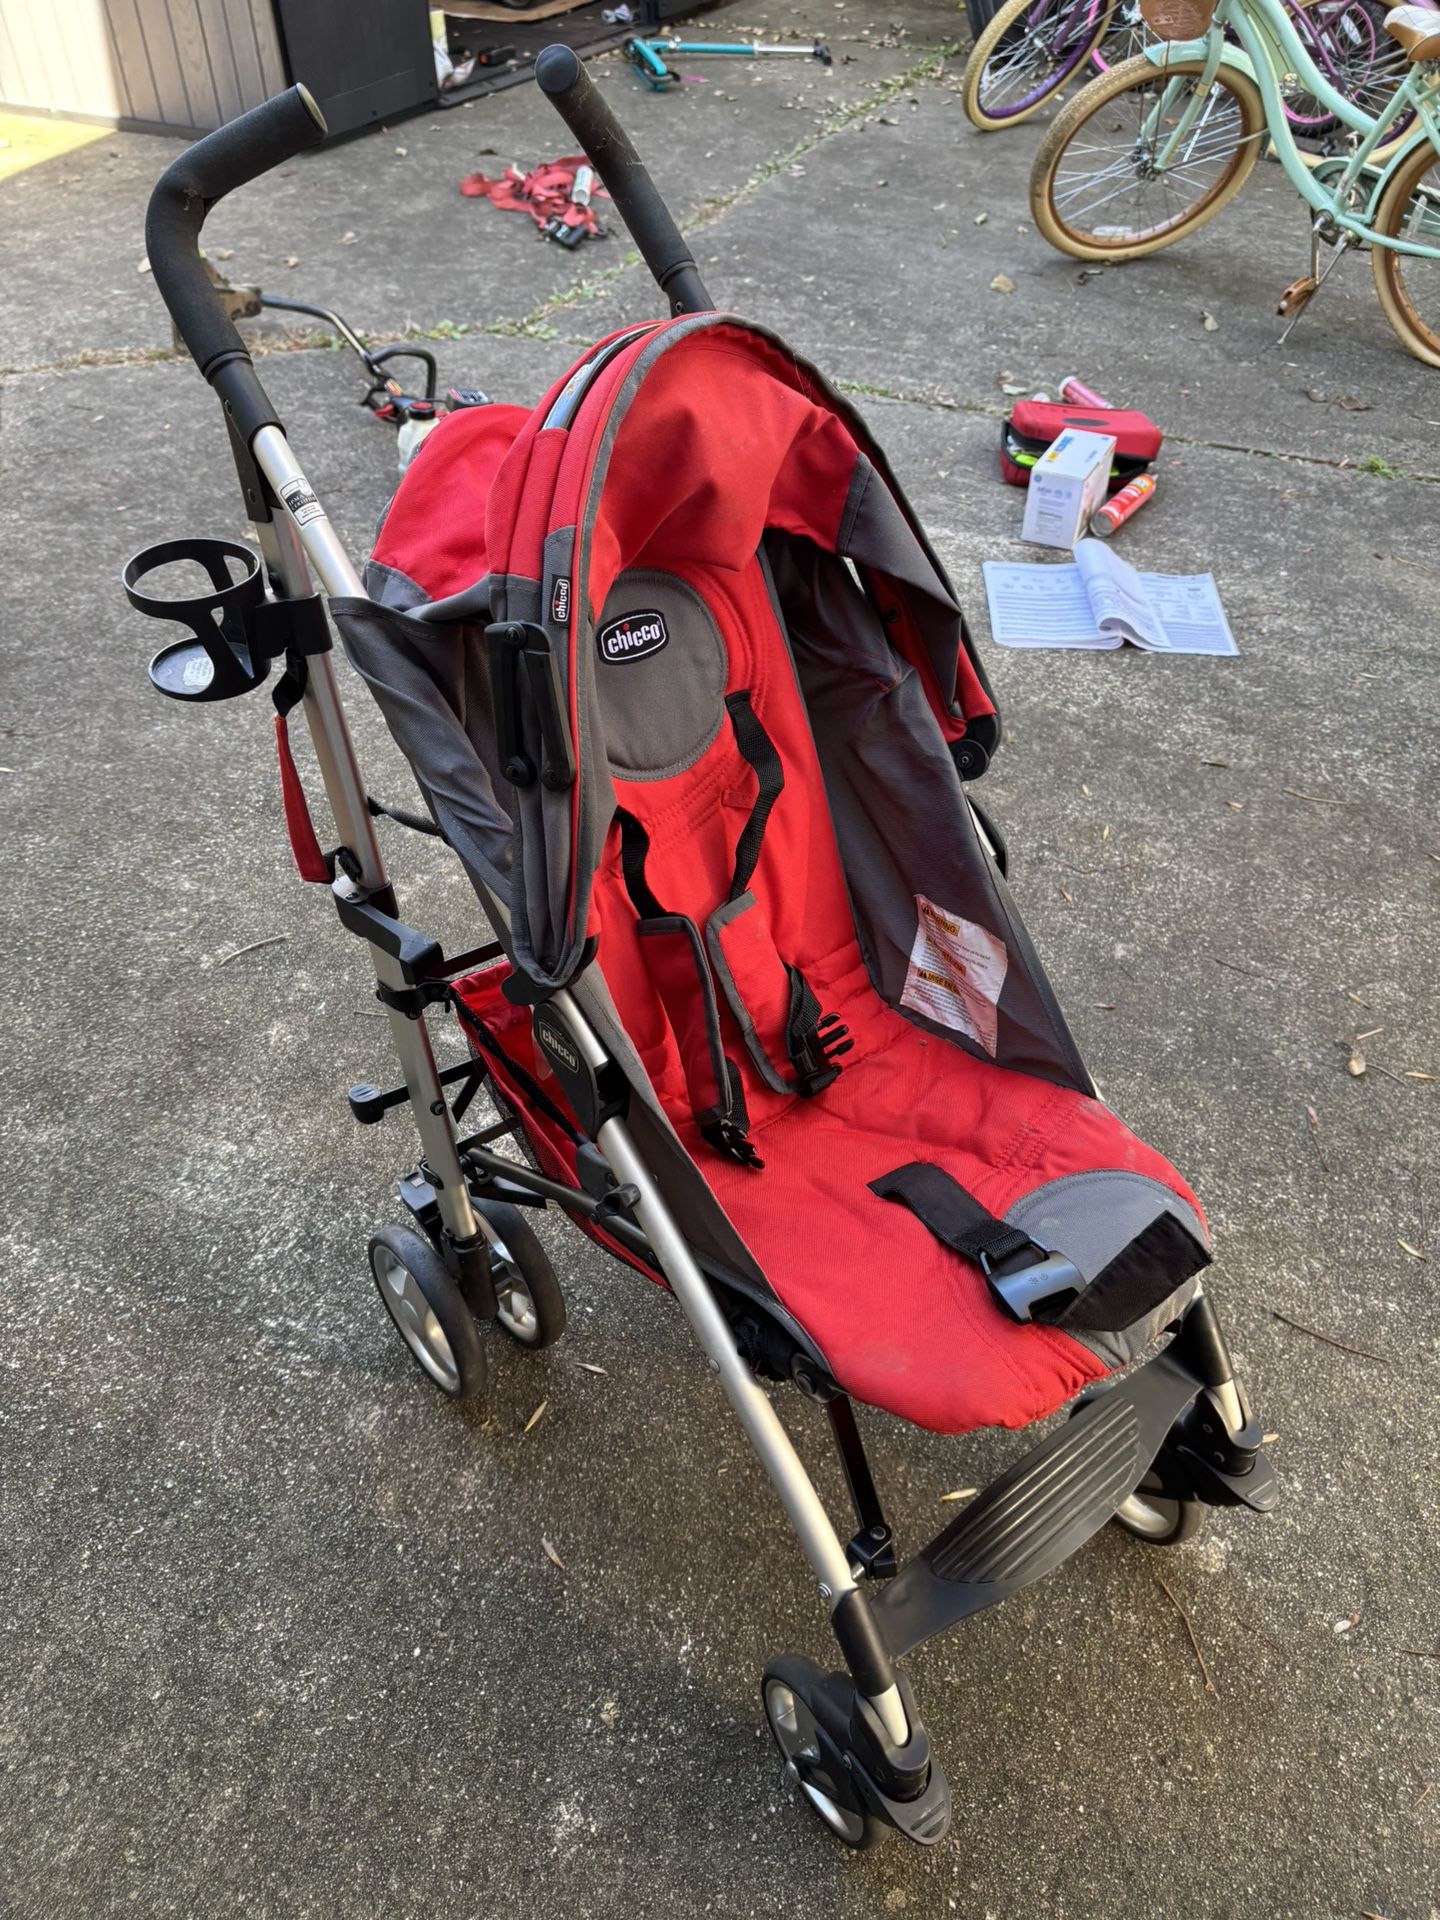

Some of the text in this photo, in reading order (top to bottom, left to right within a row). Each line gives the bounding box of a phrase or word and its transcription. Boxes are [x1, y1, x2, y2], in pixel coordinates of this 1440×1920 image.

[554, 582, 568, 618] chicco
[606, 623, 661, 654] chicco
[542, 1030, 576, 1067] chicco
